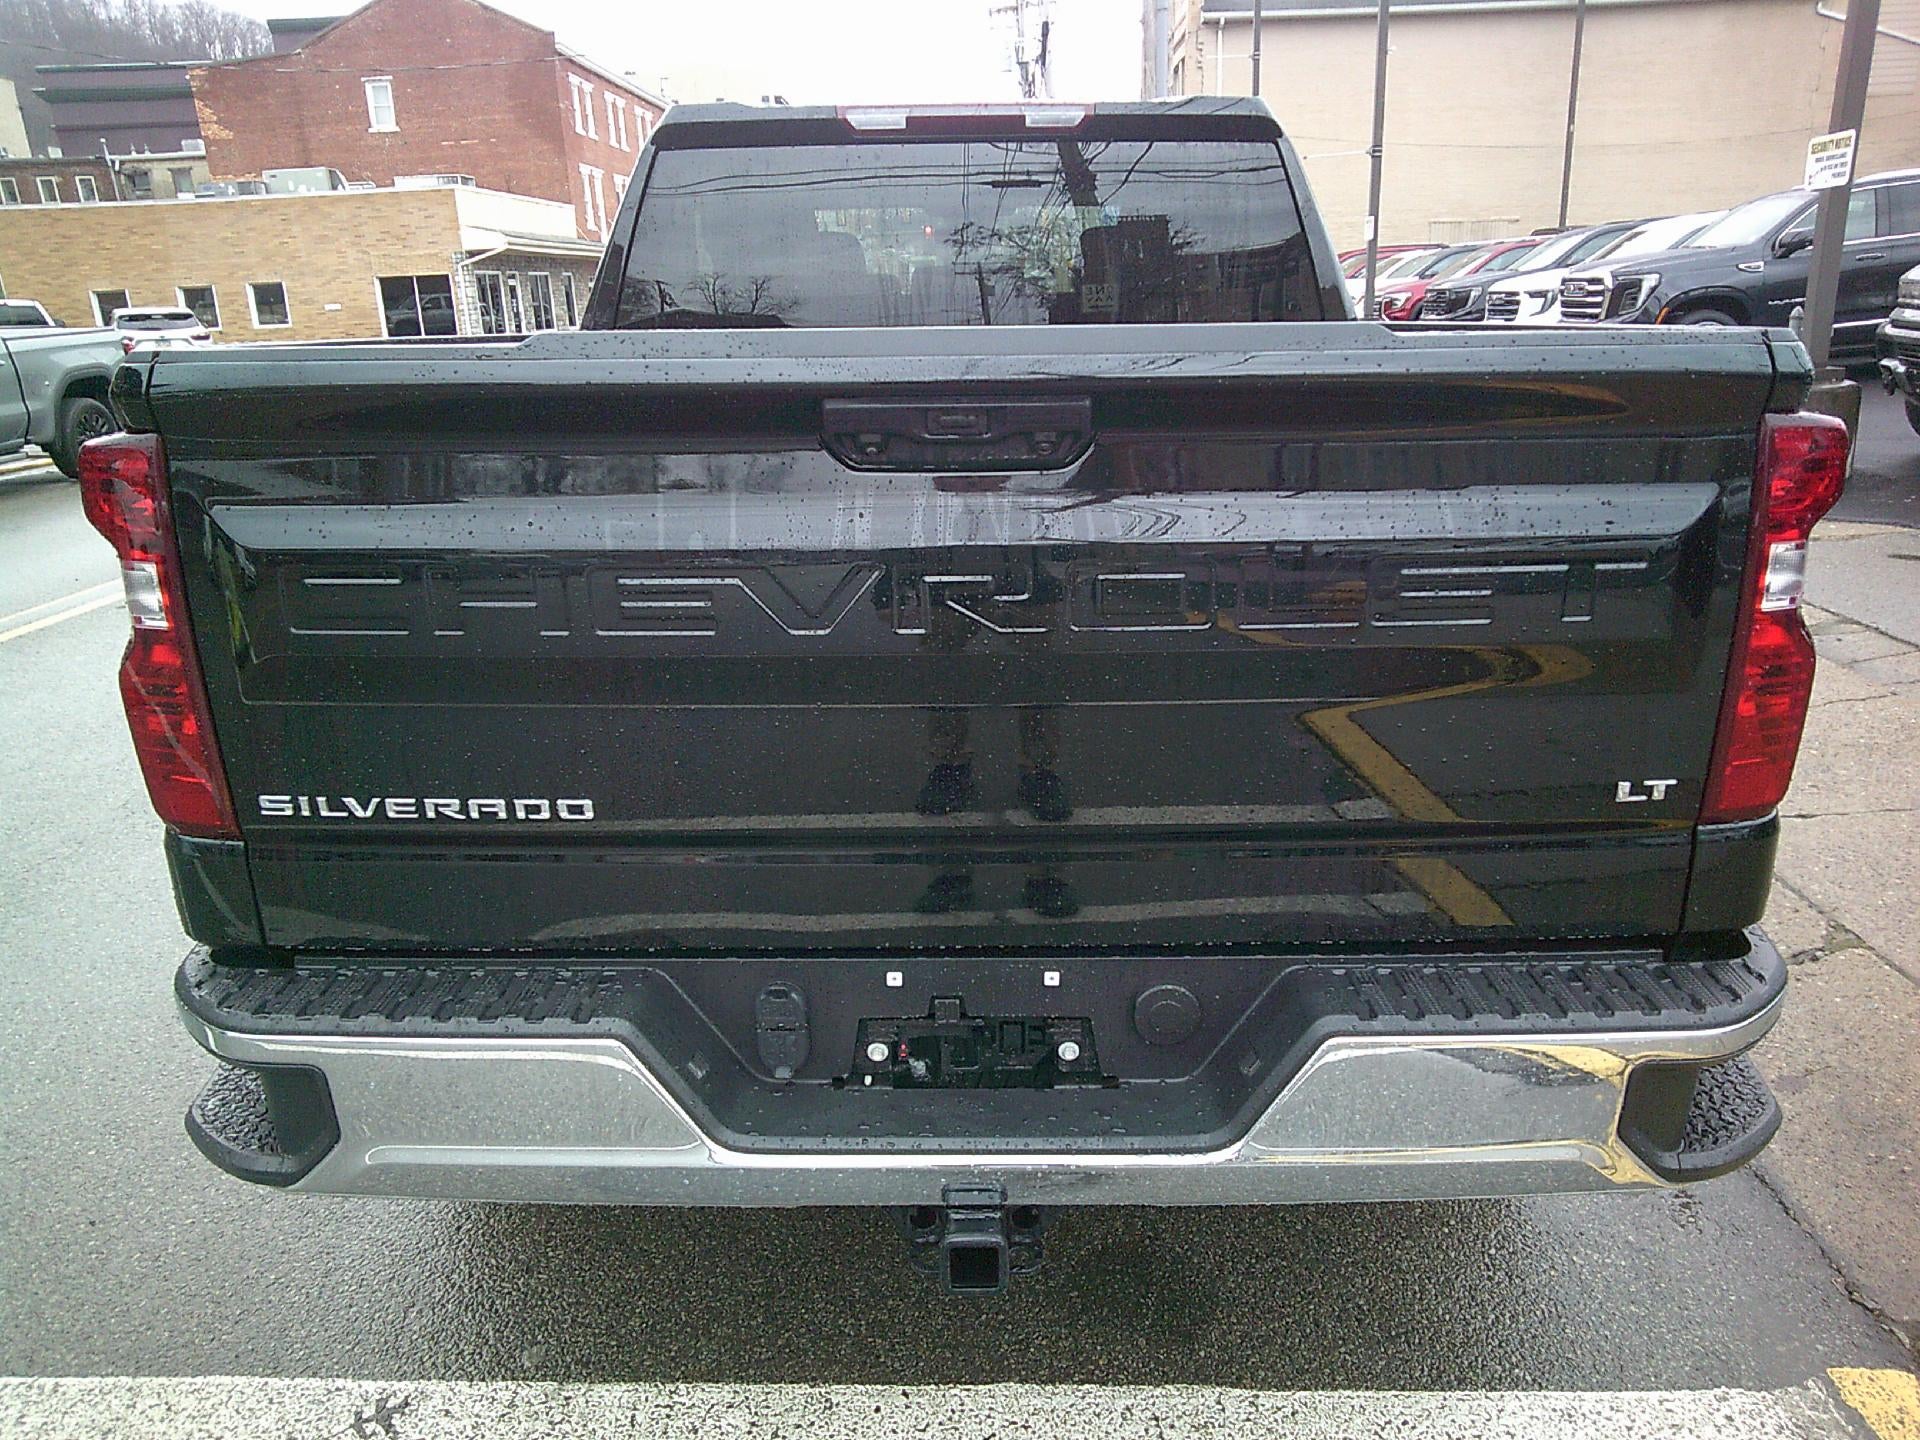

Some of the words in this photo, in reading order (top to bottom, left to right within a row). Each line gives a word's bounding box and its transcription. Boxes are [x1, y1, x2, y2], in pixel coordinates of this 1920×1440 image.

[280, 558, 1652, 632] CHEVROLET
[1615, 779, 1678, 802] LT
[258, 795, 595, 820] SILVERADO
